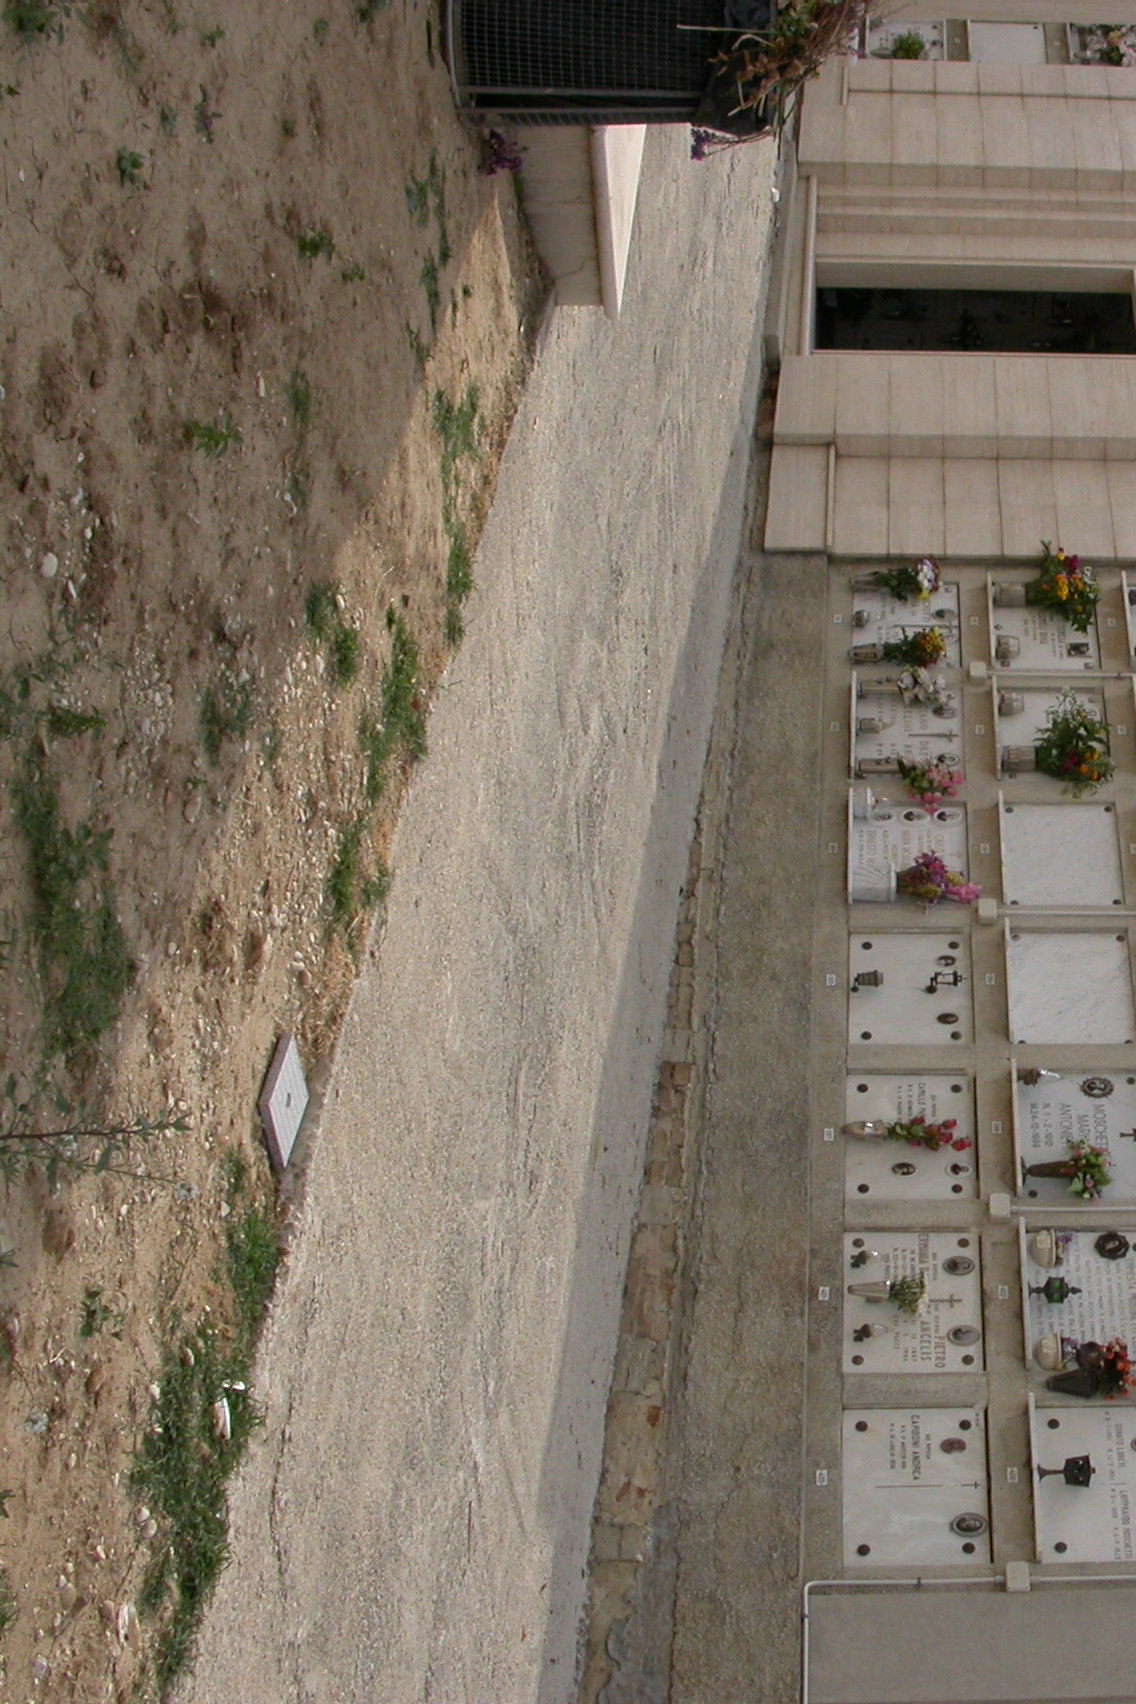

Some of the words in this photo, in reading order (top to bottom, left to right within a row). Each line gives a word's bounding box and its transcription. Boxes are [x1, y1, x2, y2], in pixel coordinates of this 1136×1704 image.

[920, 1321, 931, 1362] ANGELIS
[934, 1336, 946, 1368] PIETRO
[910, 1414, 920, 1448] CARBONI
[912, 1451, 922, 1480] ANDREA
